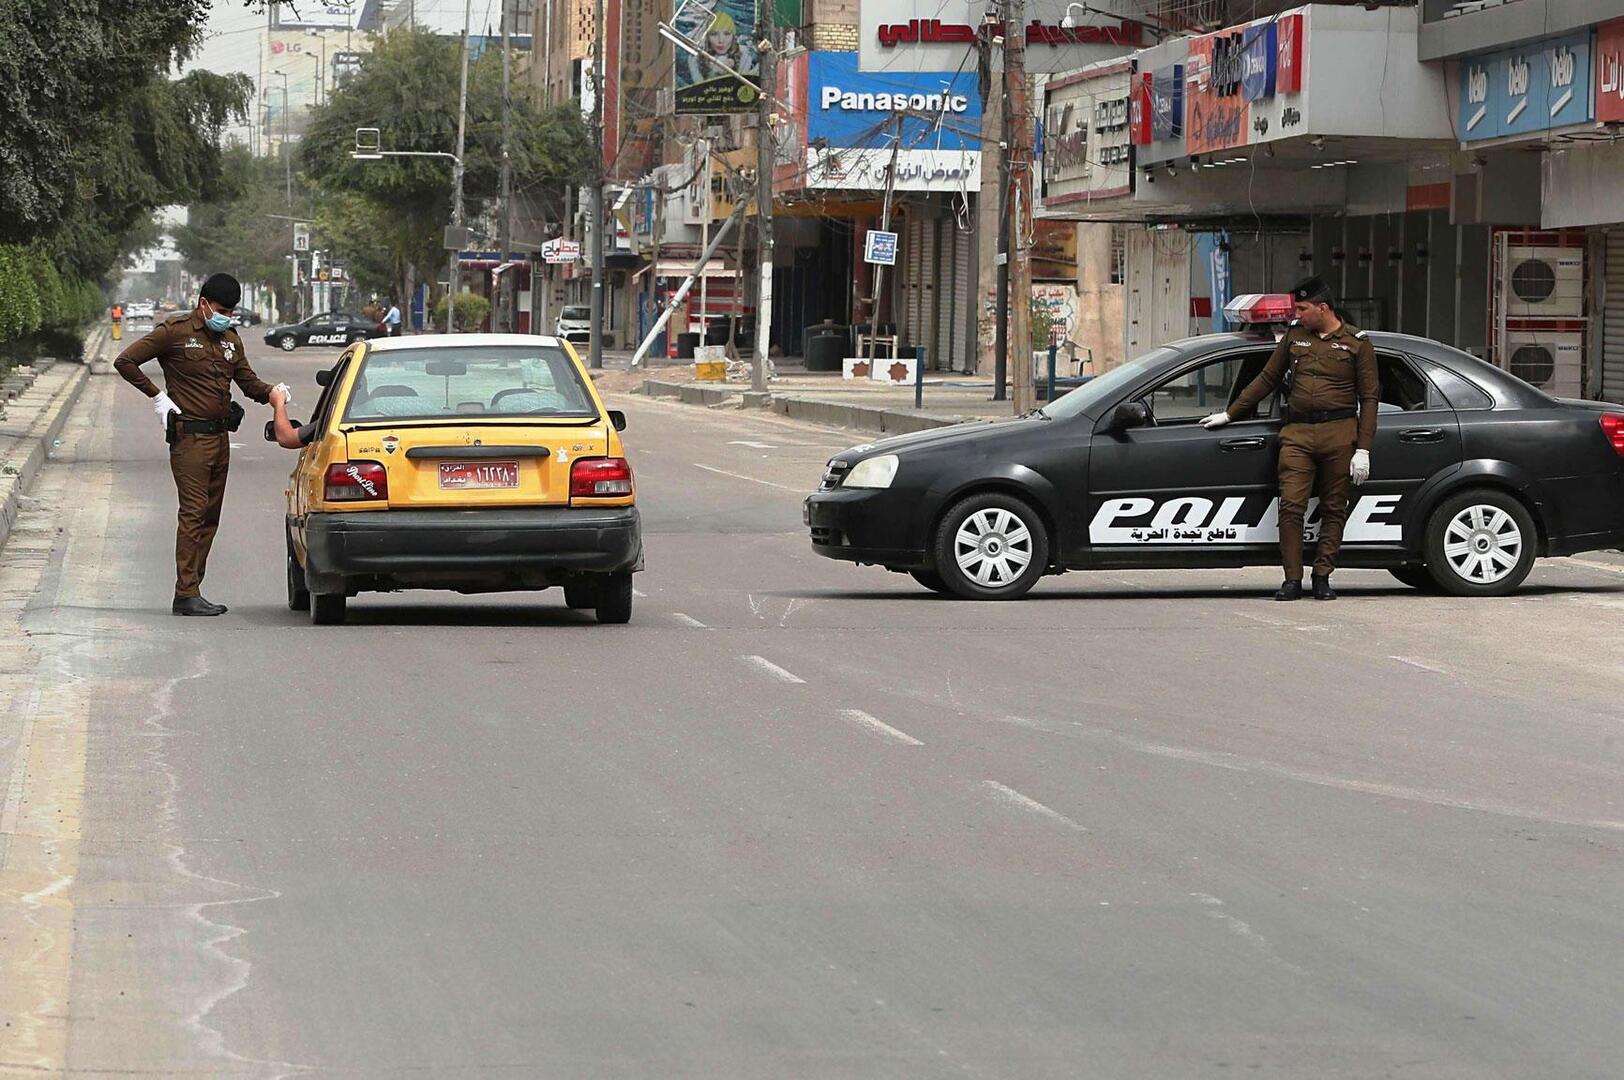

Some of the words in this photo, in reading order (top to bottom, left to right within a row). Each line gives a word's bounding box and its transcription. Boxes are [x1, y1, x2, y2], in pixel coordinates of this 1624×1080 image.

[287, 43, 302, 53] LG
[1552, 46, 1574, 88] beko
[1508, 55, 1529, 97] beko
[1468, 64, 1488, 104] beko
[821, 86, 968, 112] Panasonic
[308, 334, 348, 344] POLICE
[444, 475, 466, 483] بغداد
[1130, 528, 1168, 541] الحرية
[1173, 528, 1202, 542] نجدة
[1207, 528, 1237, 541] قاطع
